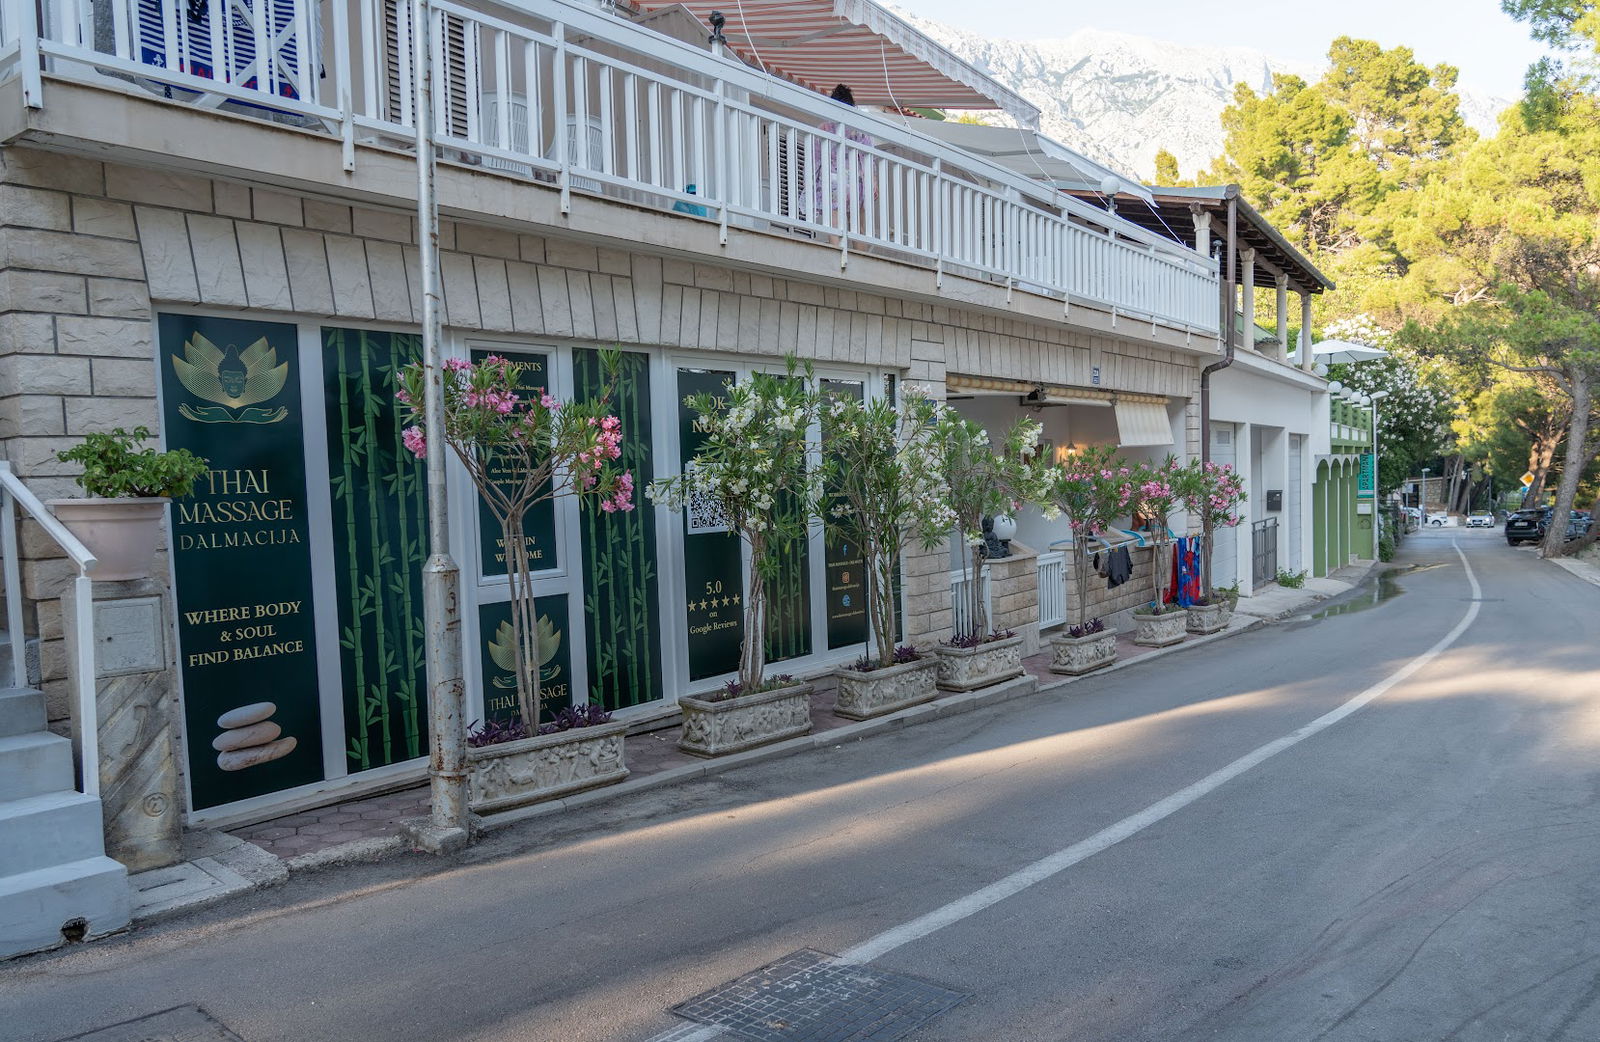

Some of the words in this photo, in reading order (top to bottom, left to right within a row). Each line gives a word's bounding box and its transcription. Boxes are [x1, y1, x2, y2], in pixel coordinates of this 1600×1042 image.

[207, 469, 270, 495] THAI
[178, 499, 293, 525] MASSAGE
[180, 528, 301, 550] DALMACIJA
[706, 580, 722, 595] 5.0
[184, 606, 251, 625] WHERE
[254, 601, 301, 618] BODY
[220, 630, 233, 642] &
[235, 624, 277, 640] SOUL
[690, 623, 712, 635] Google
[713, 620, 738, 630] Reviews
[189, 650, 230, 667] FIND
[233, 640, 304, 661] BALANCE
[487, 694, 515, 712] THAI
